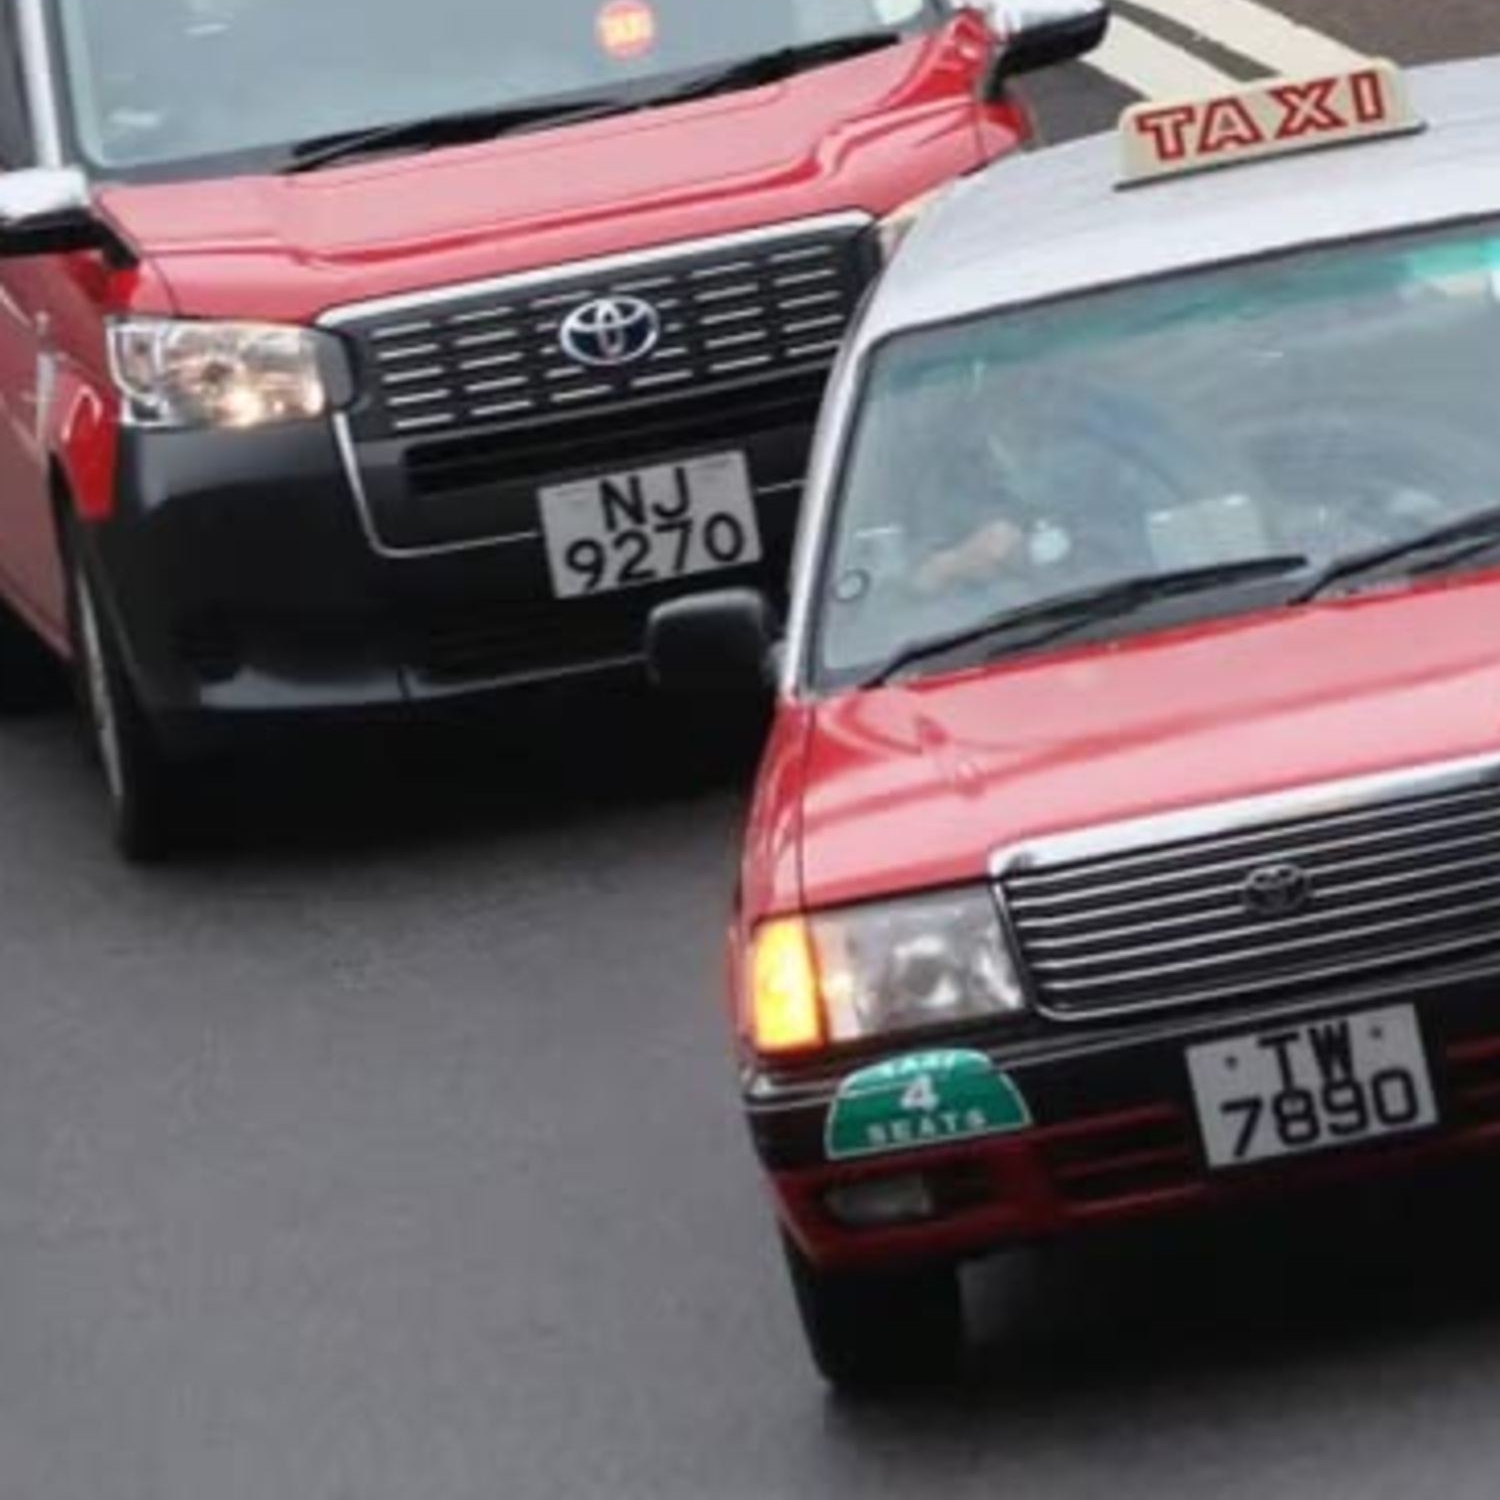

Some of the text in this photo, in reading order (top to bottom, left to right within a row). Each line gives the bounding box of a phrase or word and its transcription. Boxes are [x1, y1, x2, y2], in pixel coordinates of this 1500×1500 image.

[1134, 70, 1386, 161] TAXI
[601, 466, 692, 531] NJ
[564, 511, 745, 592] 9270
[902, 1074, 940, 1110] 4
[1257, 1018, 1355, 1090] TW
[1220, 1067, 1418, 1158] 7890
